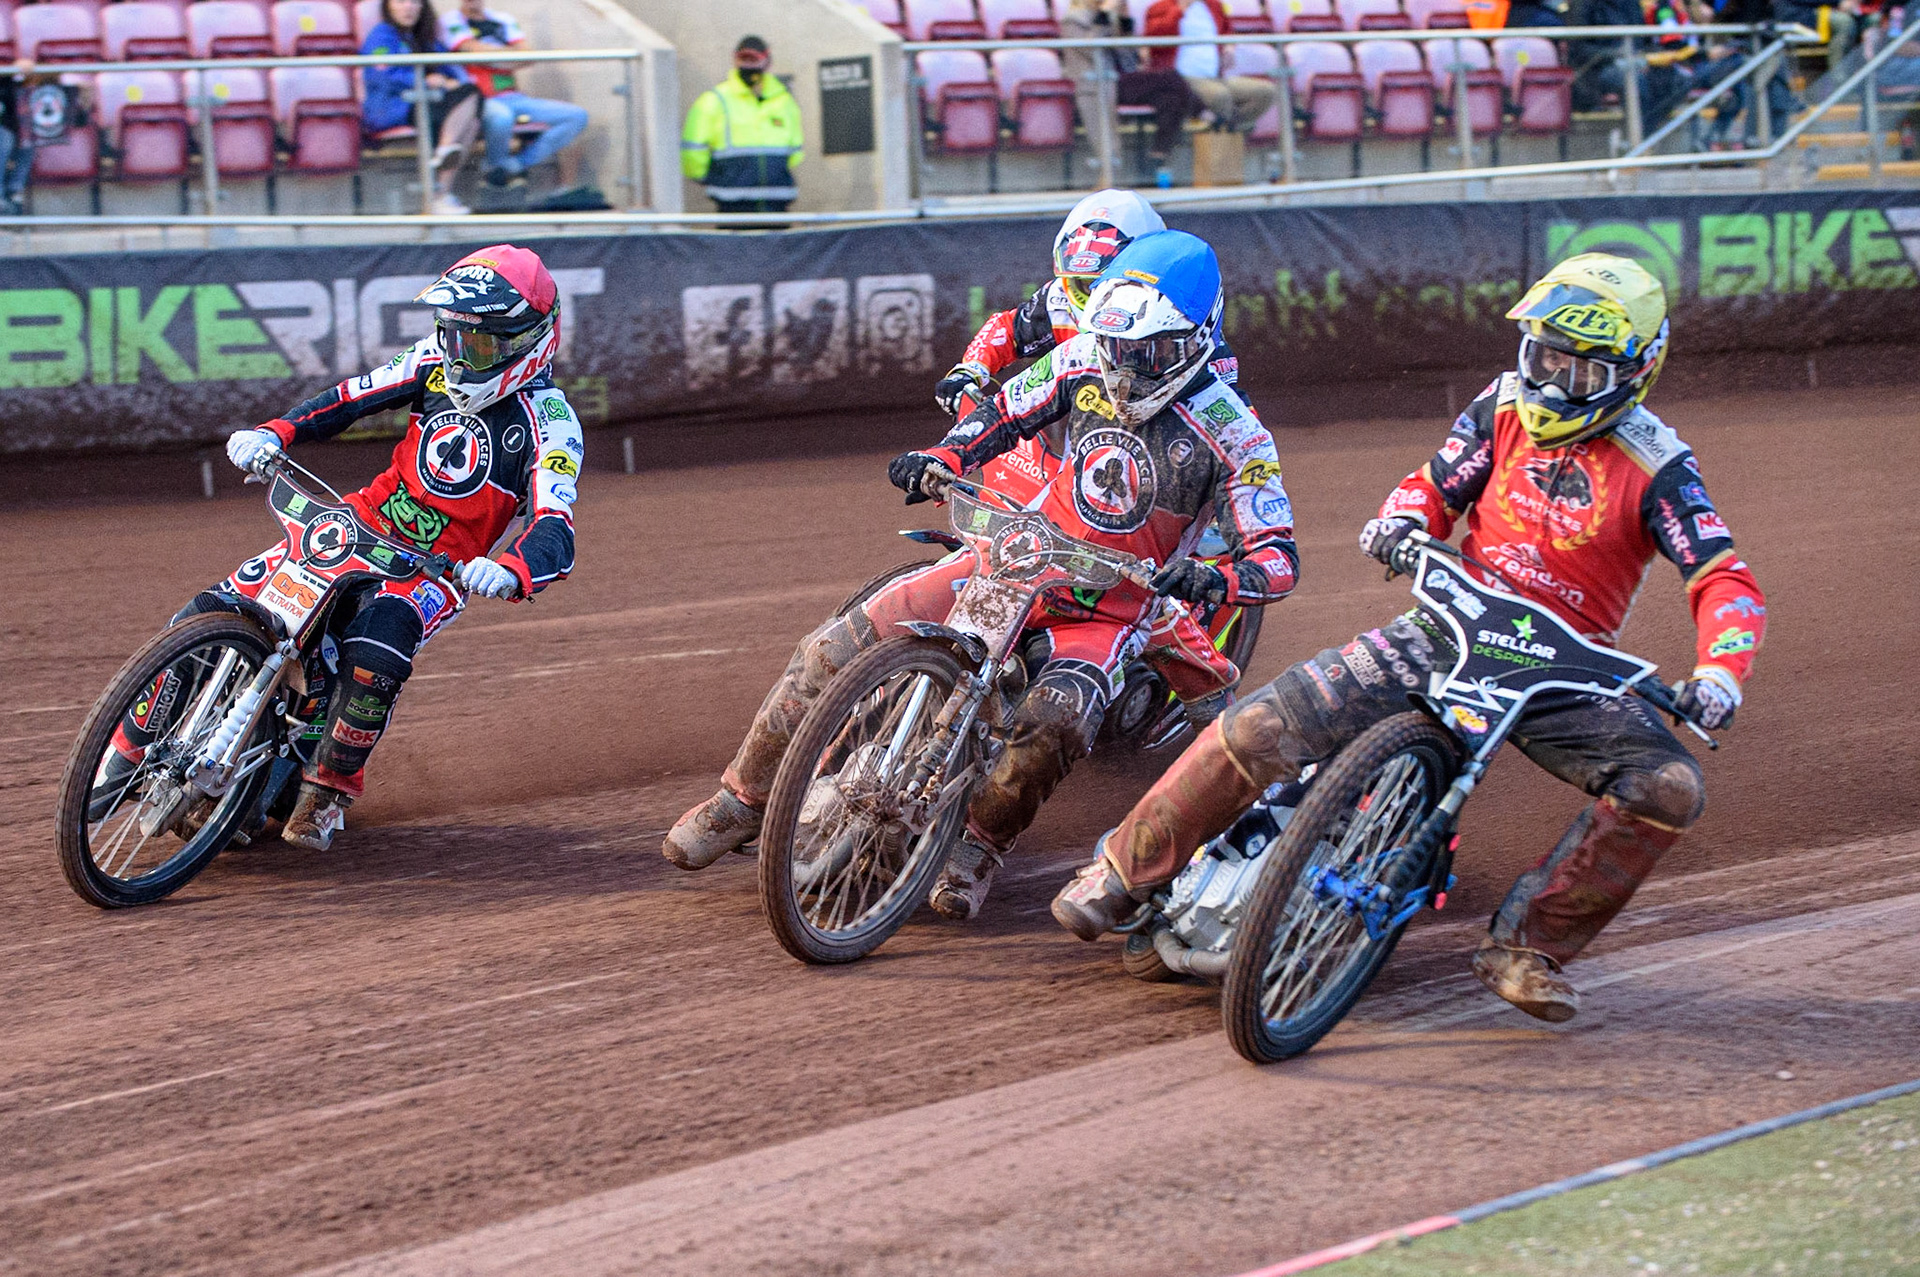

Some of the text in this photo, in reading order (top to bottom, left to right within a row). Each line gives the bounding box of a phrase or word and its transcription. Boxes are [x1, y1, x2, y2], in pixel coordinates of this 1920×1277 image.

[1699, 207, 1920, 297] BIKE
[0, 267, 604, 389] BIKERIGT
[431, 416, 489, 467] BELLE VUE ACES
[1621, 421, 1665, 459] Crendon
[998, 451, 1049, 481] rendon
[1079, 433, 1151, 489] BELLE VUE ACE
[1508, 490, 1583, 533] PANTHERS
[313, 514, 355, 544] BELLE VUE ACE
[264, 590, 306, 619] FILTRATION
[1471, 643, 1552, 672] DESPATCH
[1477, 629, 1558, 660] STELLAR
[348, 701, 371, 716] ROCK
[335, 721, 378, 744] NGK
